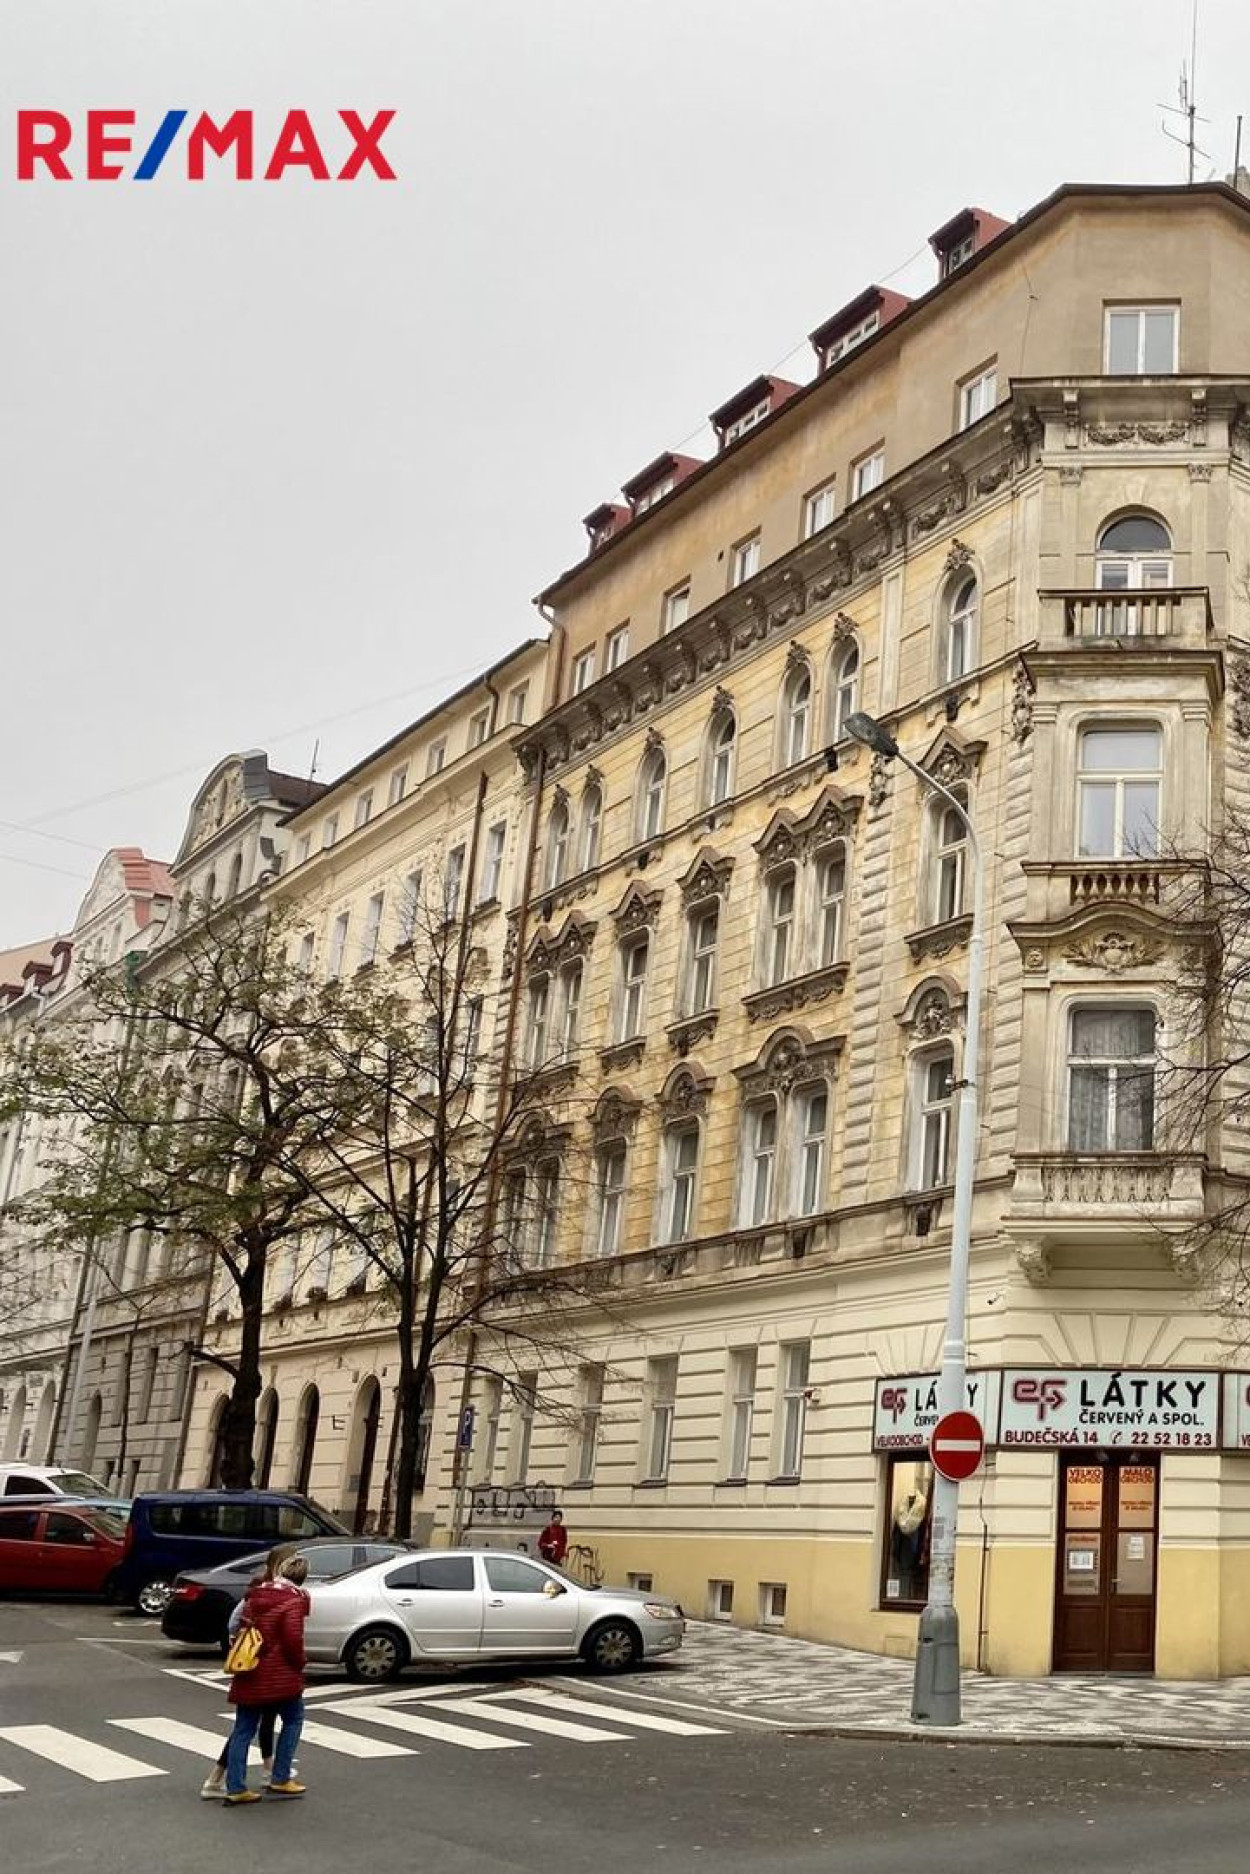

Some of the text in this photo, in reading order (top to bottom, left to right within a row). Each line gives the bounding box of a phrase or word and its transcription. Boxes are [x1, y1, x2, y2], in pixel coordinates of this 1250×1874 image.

[915, 1379, 978, 1411] LÁY
[1080, 1372, 1206, 1408] LÁTKY
[1079, 1409, 1204, 1425] ČERVENÝ A SPOL.
[1005, 1427, 1212, 1445] BUDEČSKÁ 14 22 52 18 23
